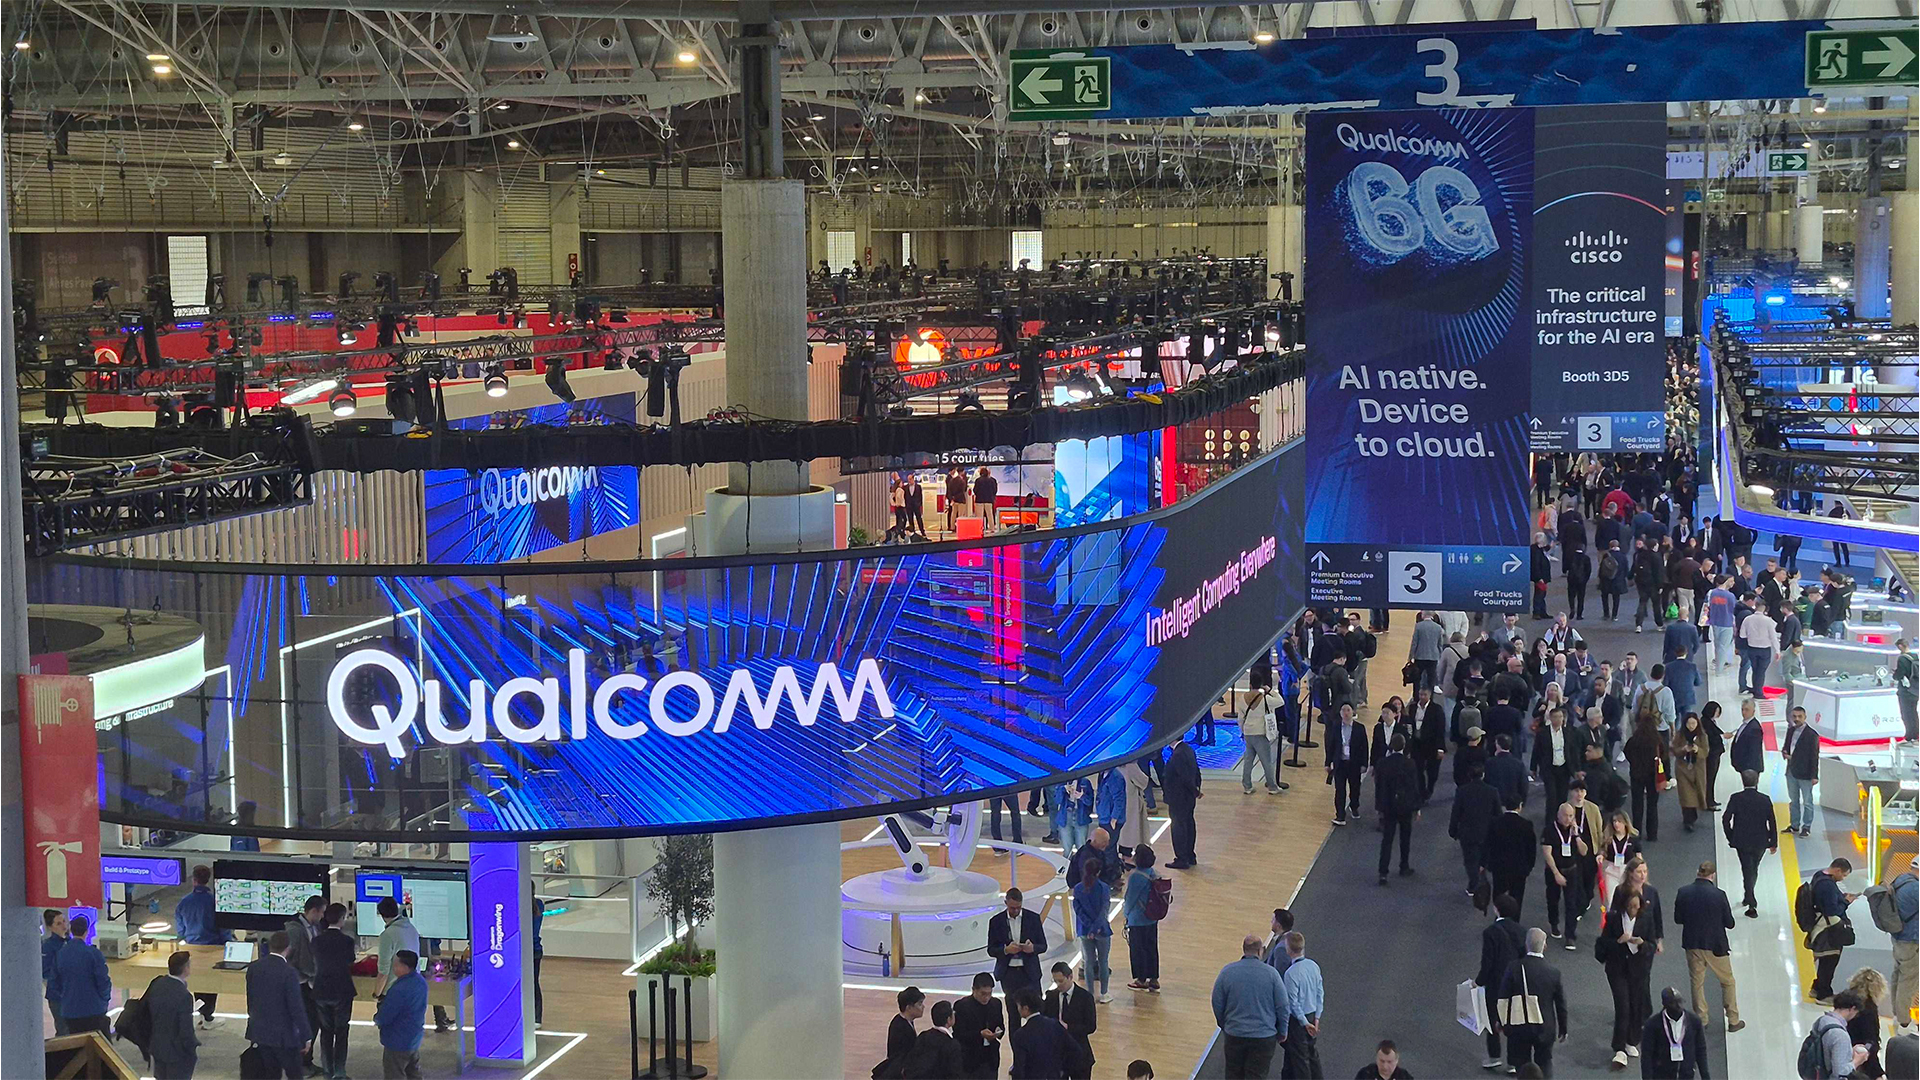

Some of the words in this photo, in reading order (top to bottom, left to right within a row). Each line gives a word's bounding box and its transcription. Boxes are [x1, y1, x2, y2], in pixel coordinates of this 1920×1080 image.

[1417, 38, 1460, 106] 3
[1336, 123, 1470, 160] Qualcomm
[1347, 161, 1500, 257] 6G
[1546, 288, 1580, 303] The
[1586, 286, 1646, 302] critical
[1536, 308, 1657, 324] infrastructure
[1538, 330, 1563, 345] for
[1568, 329, 1597, 344] the
[1601, 328, 1620, 344] AI
[1625, 330, 1655, 343] era
[1338, 364, 1371, 390] AI
[1378, 364, 1487, 390] native.
[1562, 371, 1600, 382] Booth
[1603, 370, 1630, 382] 3D5
[1358, 398, 1469, 424] Device
[1354, 433, 1388, 457] to
[1396, 431, 1495, 458] cloud.
[1588, 423, 1602, 442] 3
[1146, 588, 1200, 647] Intelligent
[1202, 561, 1240, 613] Computing
[1241, 536, 1276, 582] Everywhere
[1404, 562, 1427, 594] 3
[326, 648, 895, 758] Qualcomm
[495, 904, 505, 951] Dragonwing
